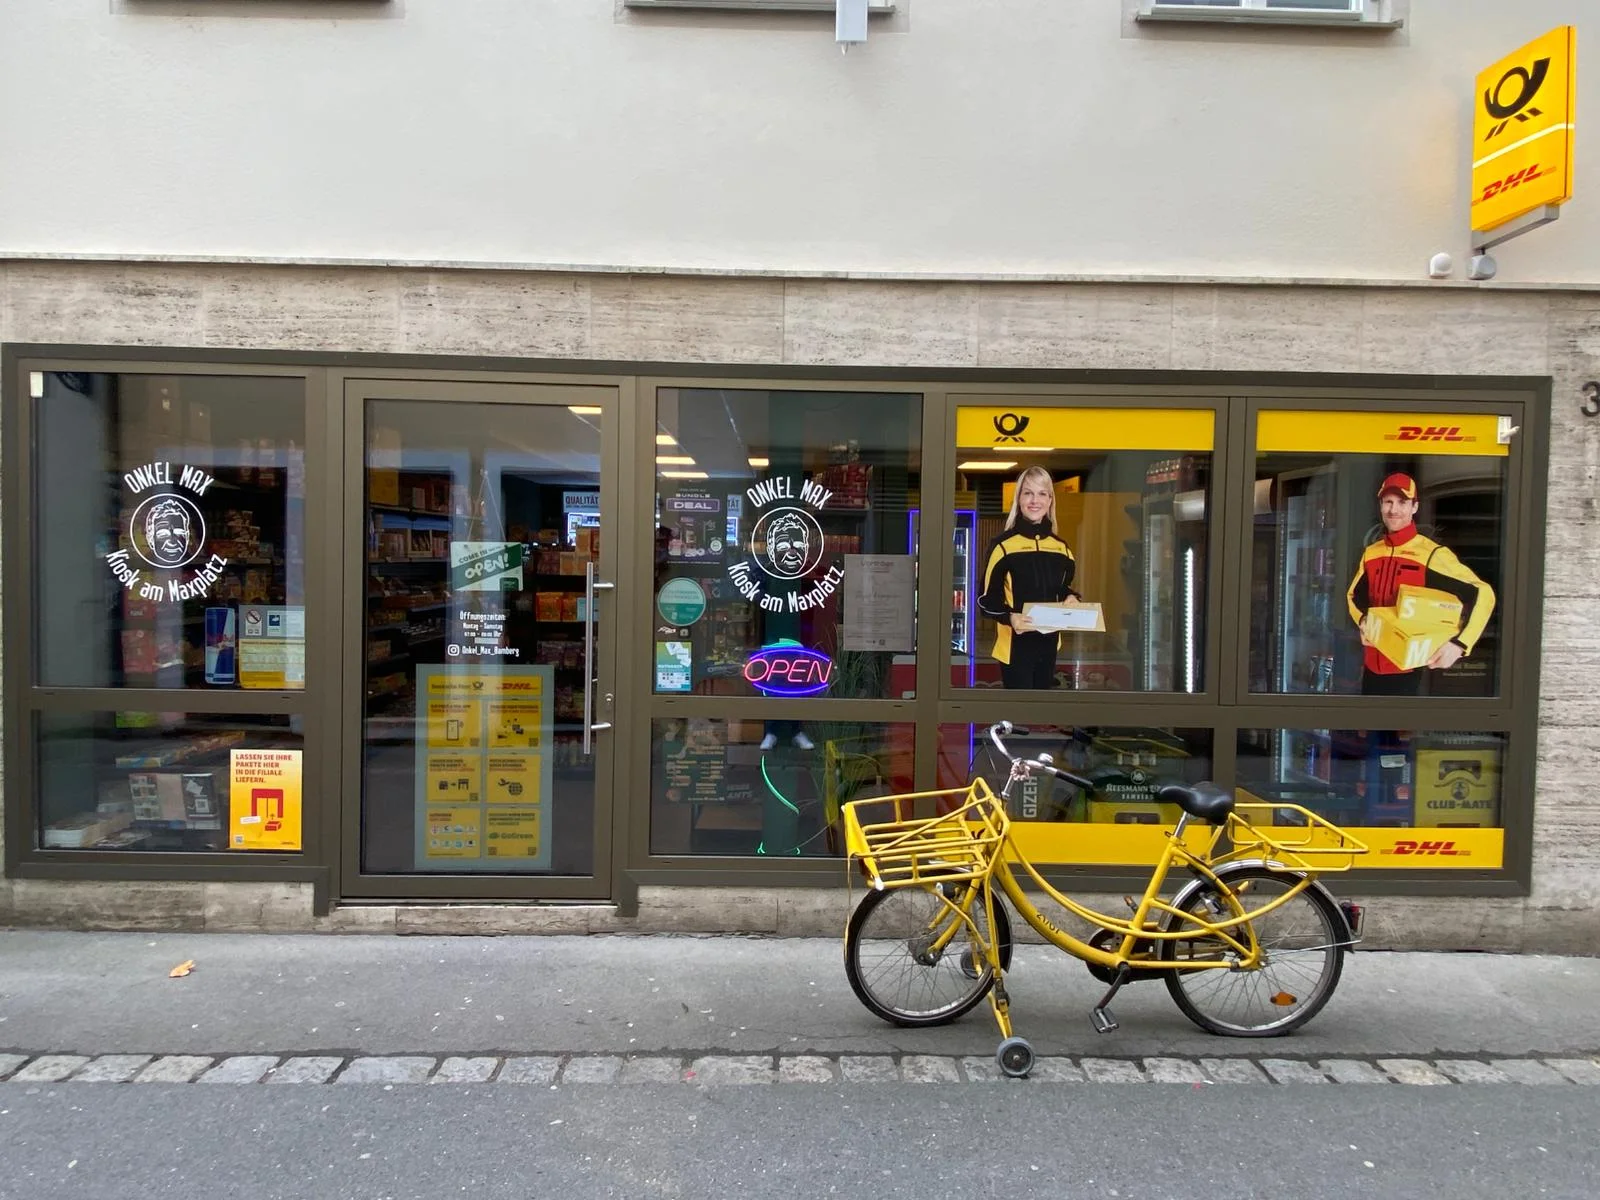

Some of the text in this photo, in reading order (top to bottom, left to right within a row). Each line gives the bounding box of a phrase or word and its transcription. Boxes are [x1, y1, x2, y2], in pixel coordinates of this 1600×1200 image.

[1482, 164, 1544, 201] DHL
[1396, 427, 1465, 442] DHL
[124, 462, 215, 496] ONKEL MAX
[746, 476, 833, 510] ONKEL MAX
[674, 502, 712, 510] DEAL
[105, 548, 228, 602] Kiosk am Maxplatz
[465, 552, 509, 579] OPEN!
[728, 561, 845, 613] Kiosk am Maxplatz
[1401, 597, 1416, 619] S
[1405, 638, 1432, 668] M
[744, 658, 833, 684] OPEN
[1023, 776, 1038, 818] GIZEH
[1427, 800, 1493, 809] CLUB-MATE
[1392, 841, 1458, 856] DHL
